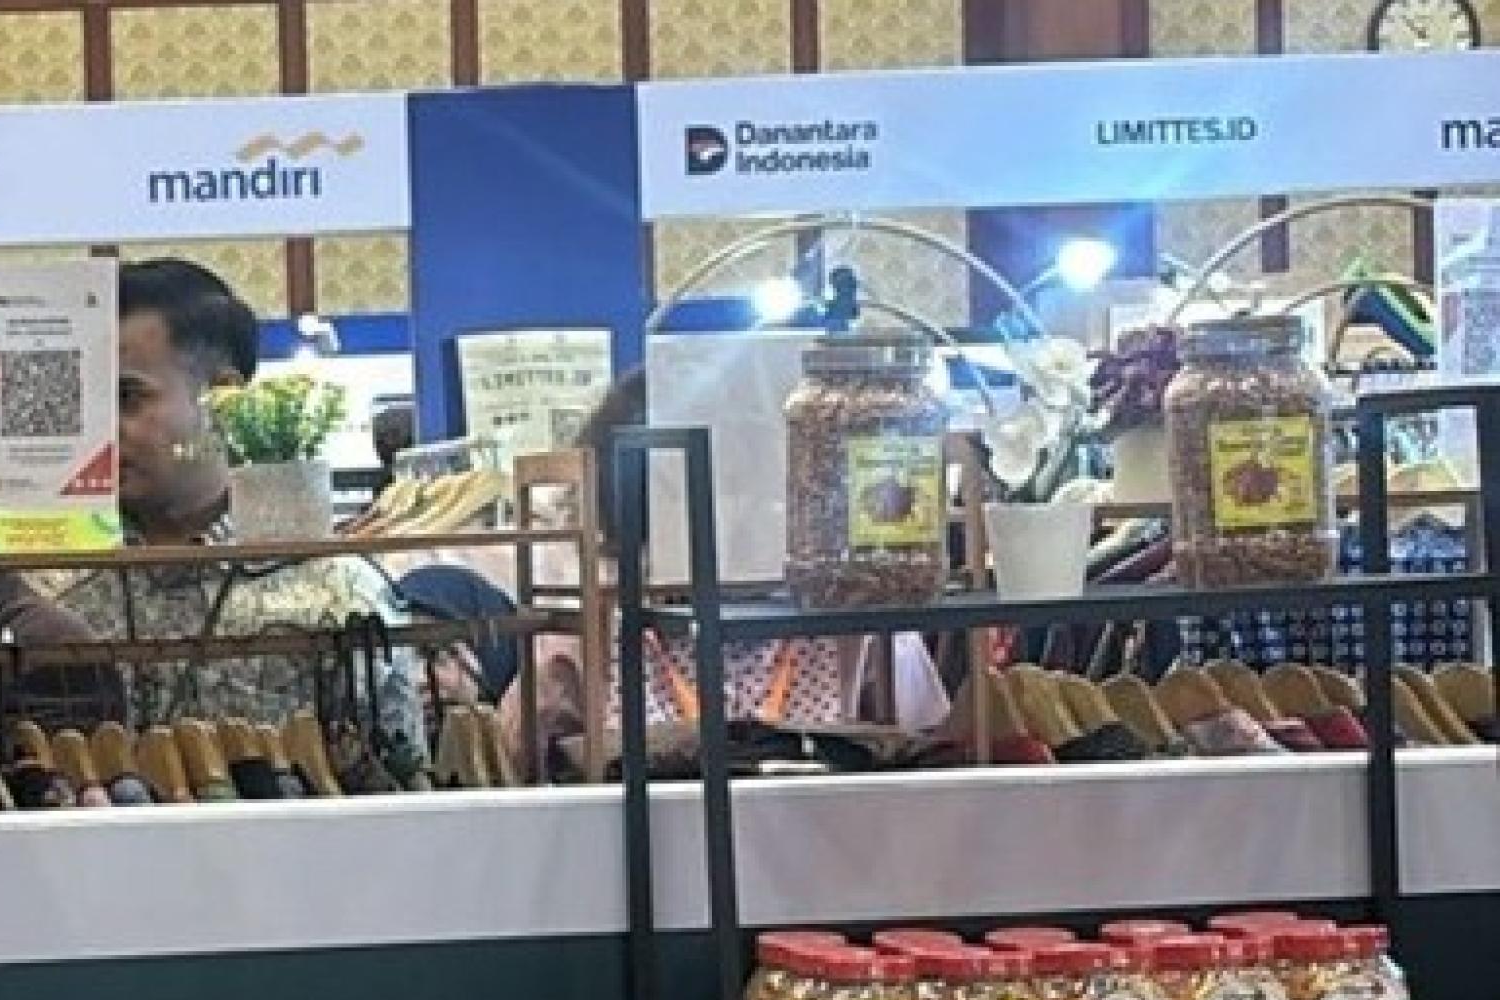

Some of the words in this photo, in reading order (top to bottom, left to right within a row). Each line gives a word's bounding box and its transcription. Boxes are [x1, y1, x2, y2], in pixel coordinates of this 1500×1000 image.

[734, 119, 879, 146] Danantara
[1097, 118, 1257, 146] LIMITTES.ID
[734, 145, 872, 175] Indonesia
[148, 159, 323, 203] mandiri
